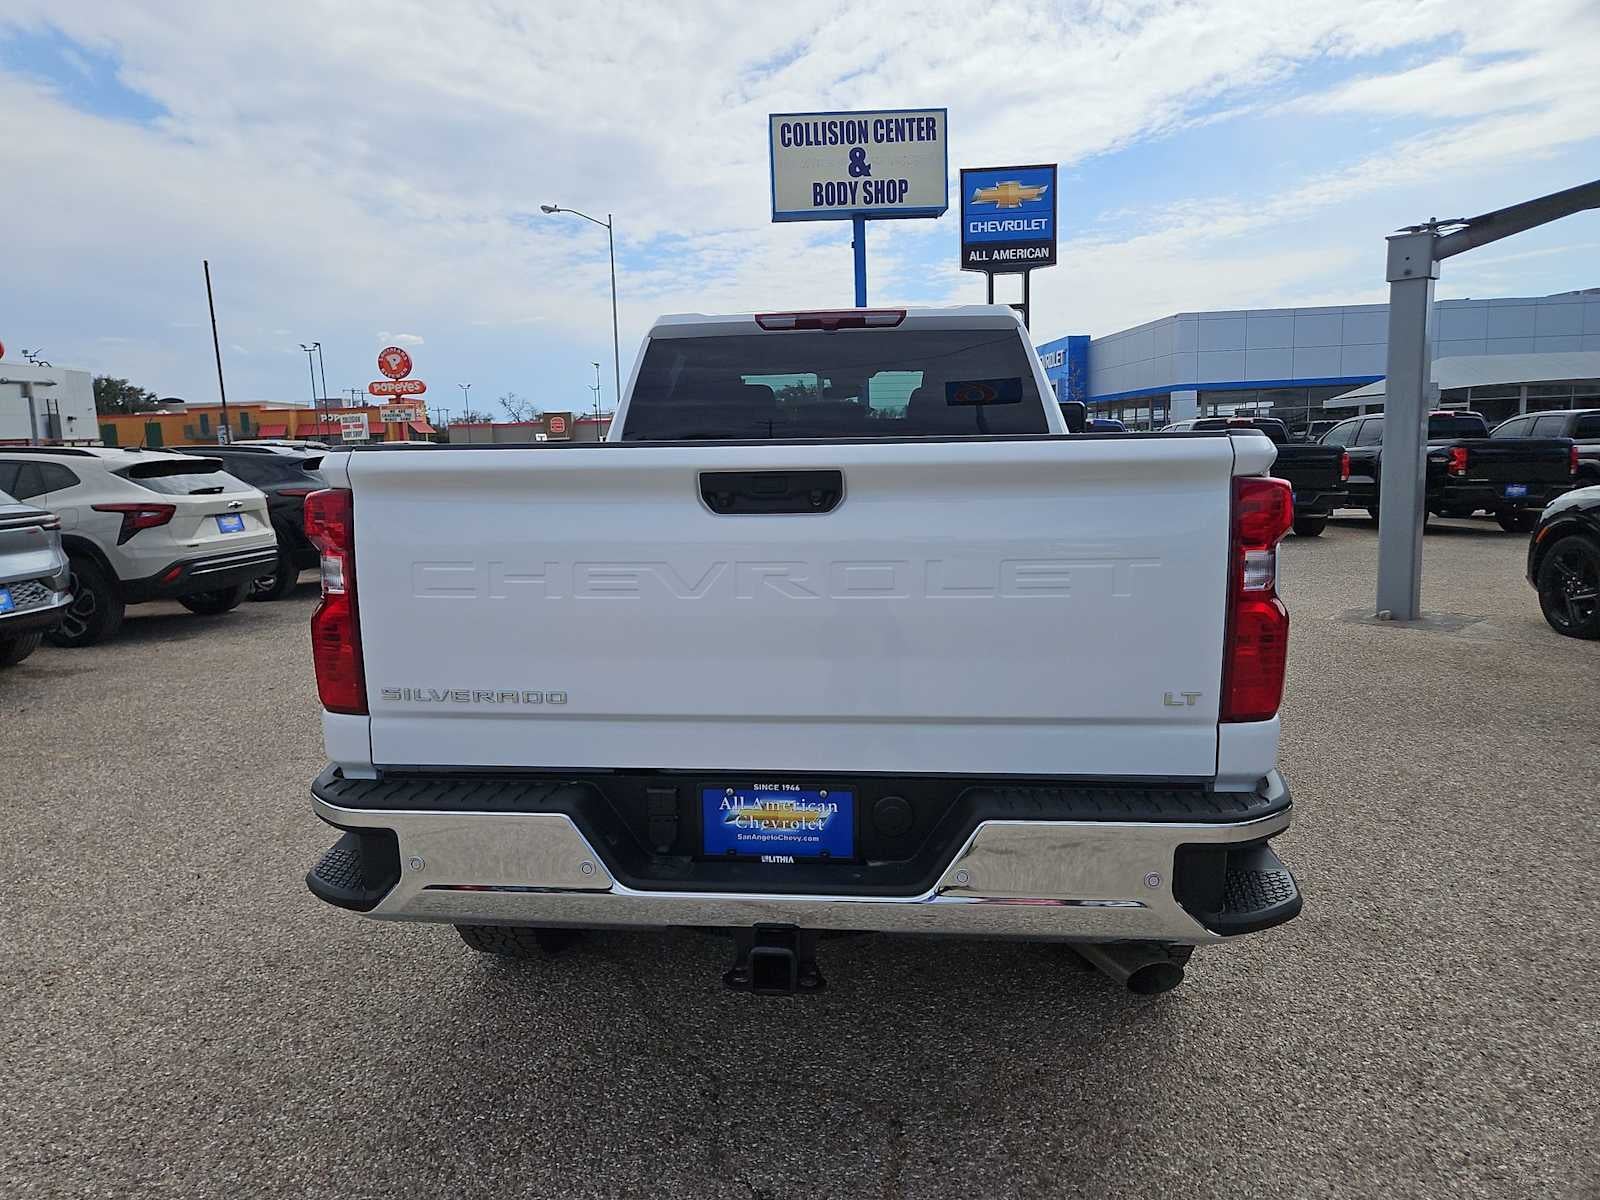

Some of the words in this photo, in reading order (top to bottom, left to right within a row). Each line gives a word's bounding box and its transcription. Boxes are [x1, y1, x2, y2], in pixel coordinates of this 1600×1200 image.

[780, 119, 869, 147] COLLISION
[873, 117, 937, 144] CENTER
[848, 147, 872, 178] &
[812, 180, 859, 207] BODY
[862, 178, 909, 205] SHOP
[969, 218, 1048, 233] CHEVROLET
[968, 250, 989, 261] ALL
[992, 247, 1049, 260] AMERICAN
[411, 556, 1161, 600] CHEVROLET
[381, 687, 568, 705] SILVERADO
[1163, 691, 1203, 706] LT
[753, 783, 780, 791] SINCE
[782, 783, 801, 792] 1946
[719, 796, 745, 811] All
[751, 797, 839, 813] American
[735, 815, 825, 831] Chevrolet
[737, 833, 820, 842] SanAngeloChevy.com
